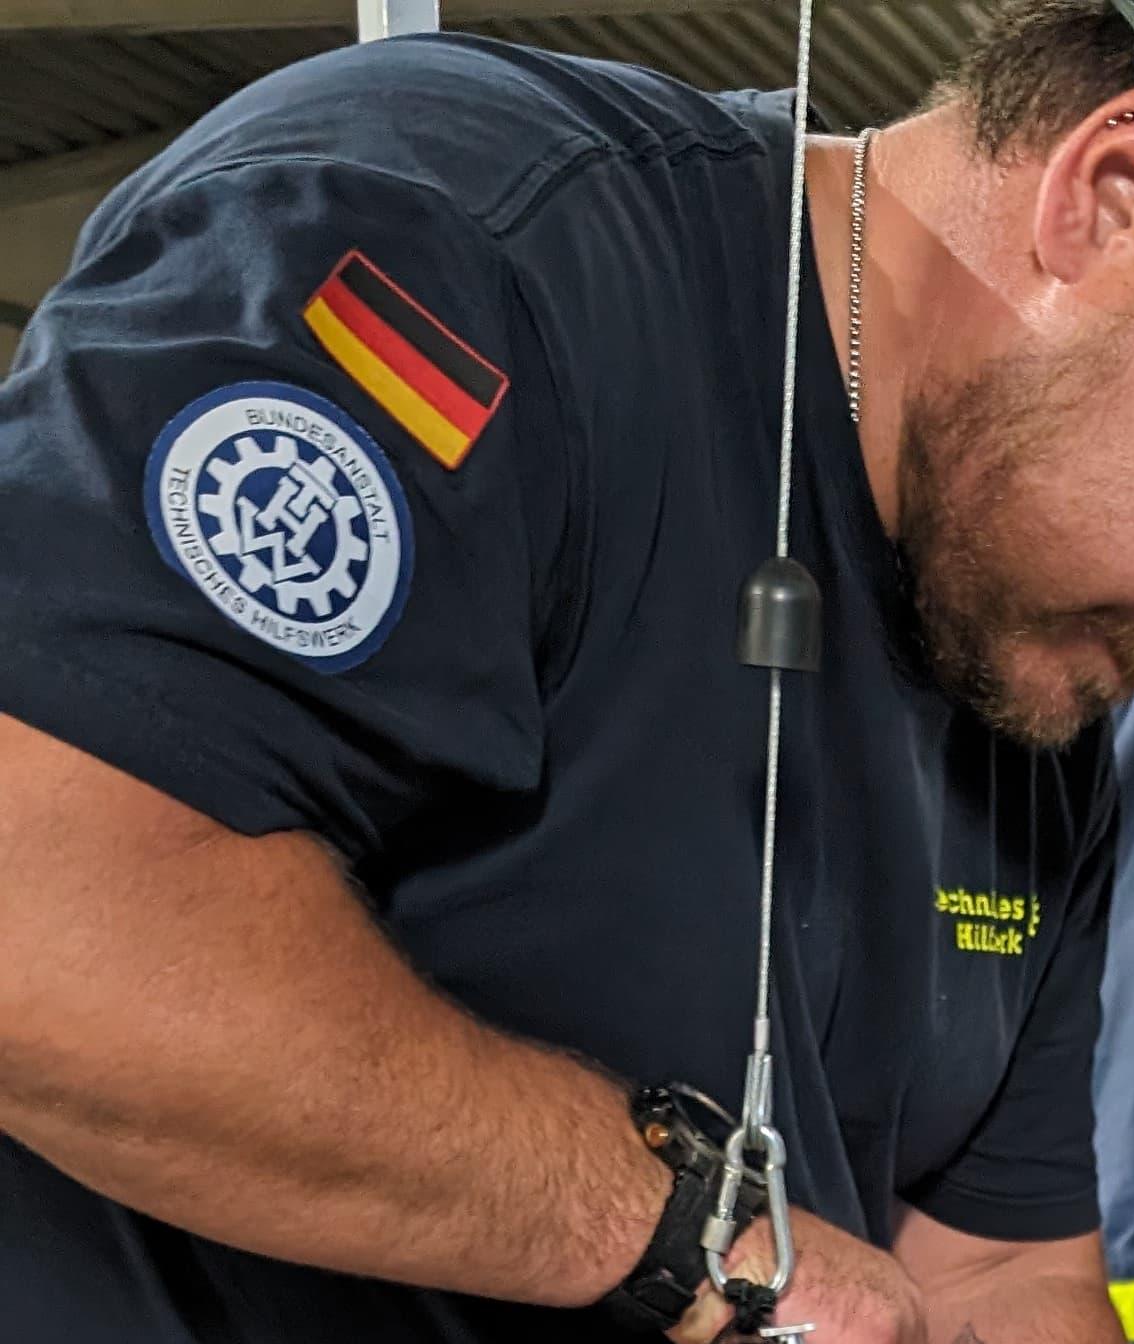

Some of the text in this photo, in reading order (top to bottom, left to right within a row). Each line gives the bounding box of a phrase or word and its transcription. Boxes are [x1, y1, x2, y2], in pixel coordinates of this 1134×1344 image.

[245, 408, 390, 544] BUNDESANSTALT
[168, 467, 363, 648] TECHNISCHES HILFSWERK
